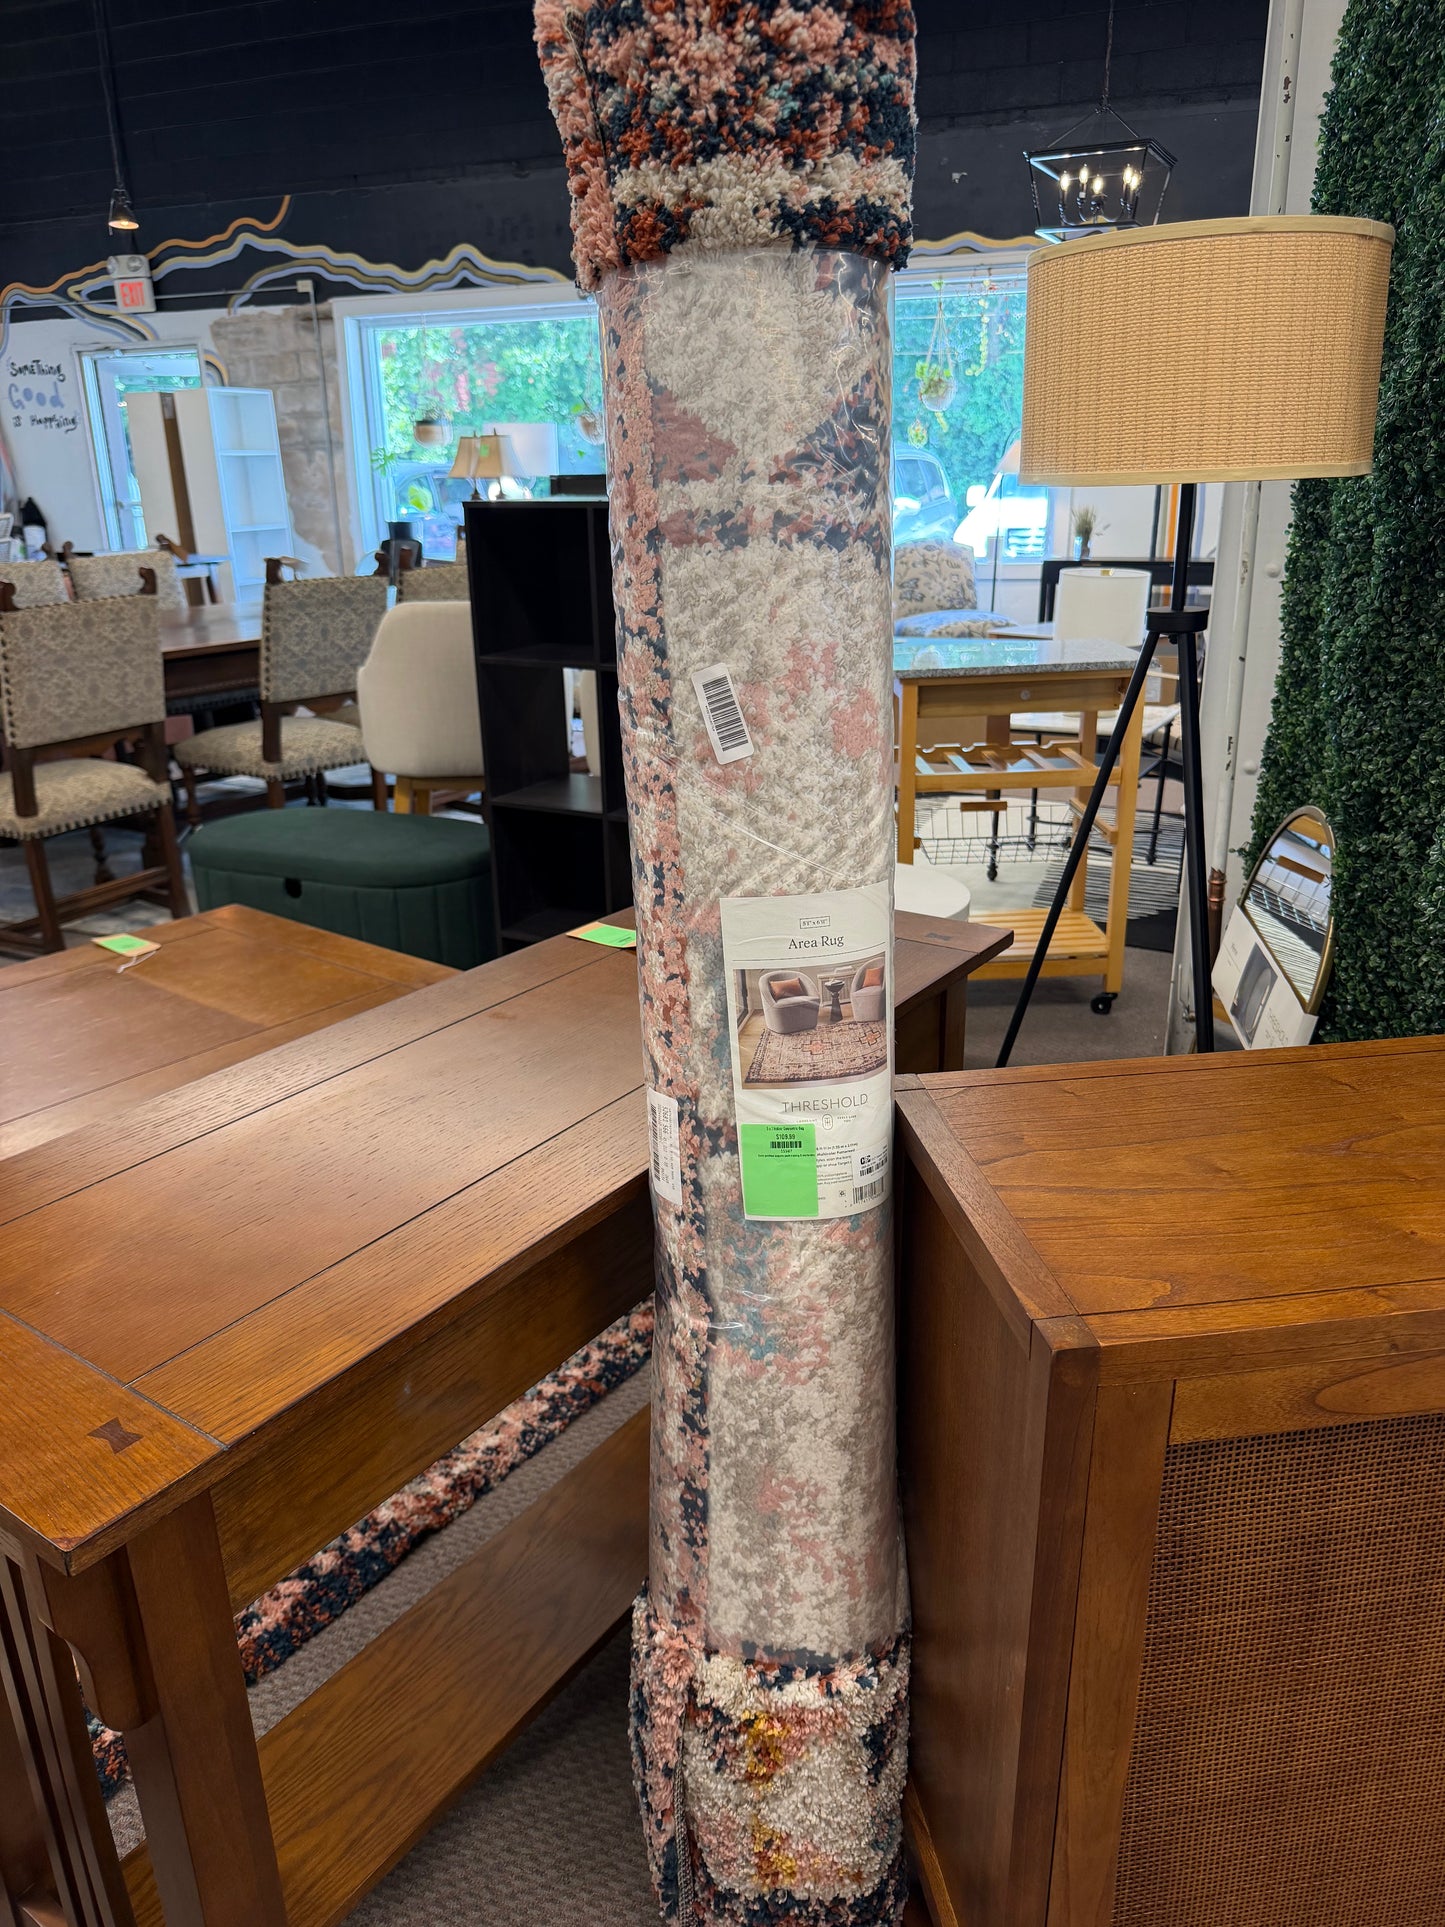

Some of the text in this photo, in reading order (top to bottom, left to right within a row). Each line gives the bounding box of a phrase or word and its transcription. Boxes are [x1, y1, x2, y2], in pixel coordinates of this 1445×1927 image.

[119, 282, 145, 308] EXIT
[8, 381, 65, 410] Good
[788, 935, 845, 949] Area Rug
[782, 1093, 868, 1113] THRESHOLD
